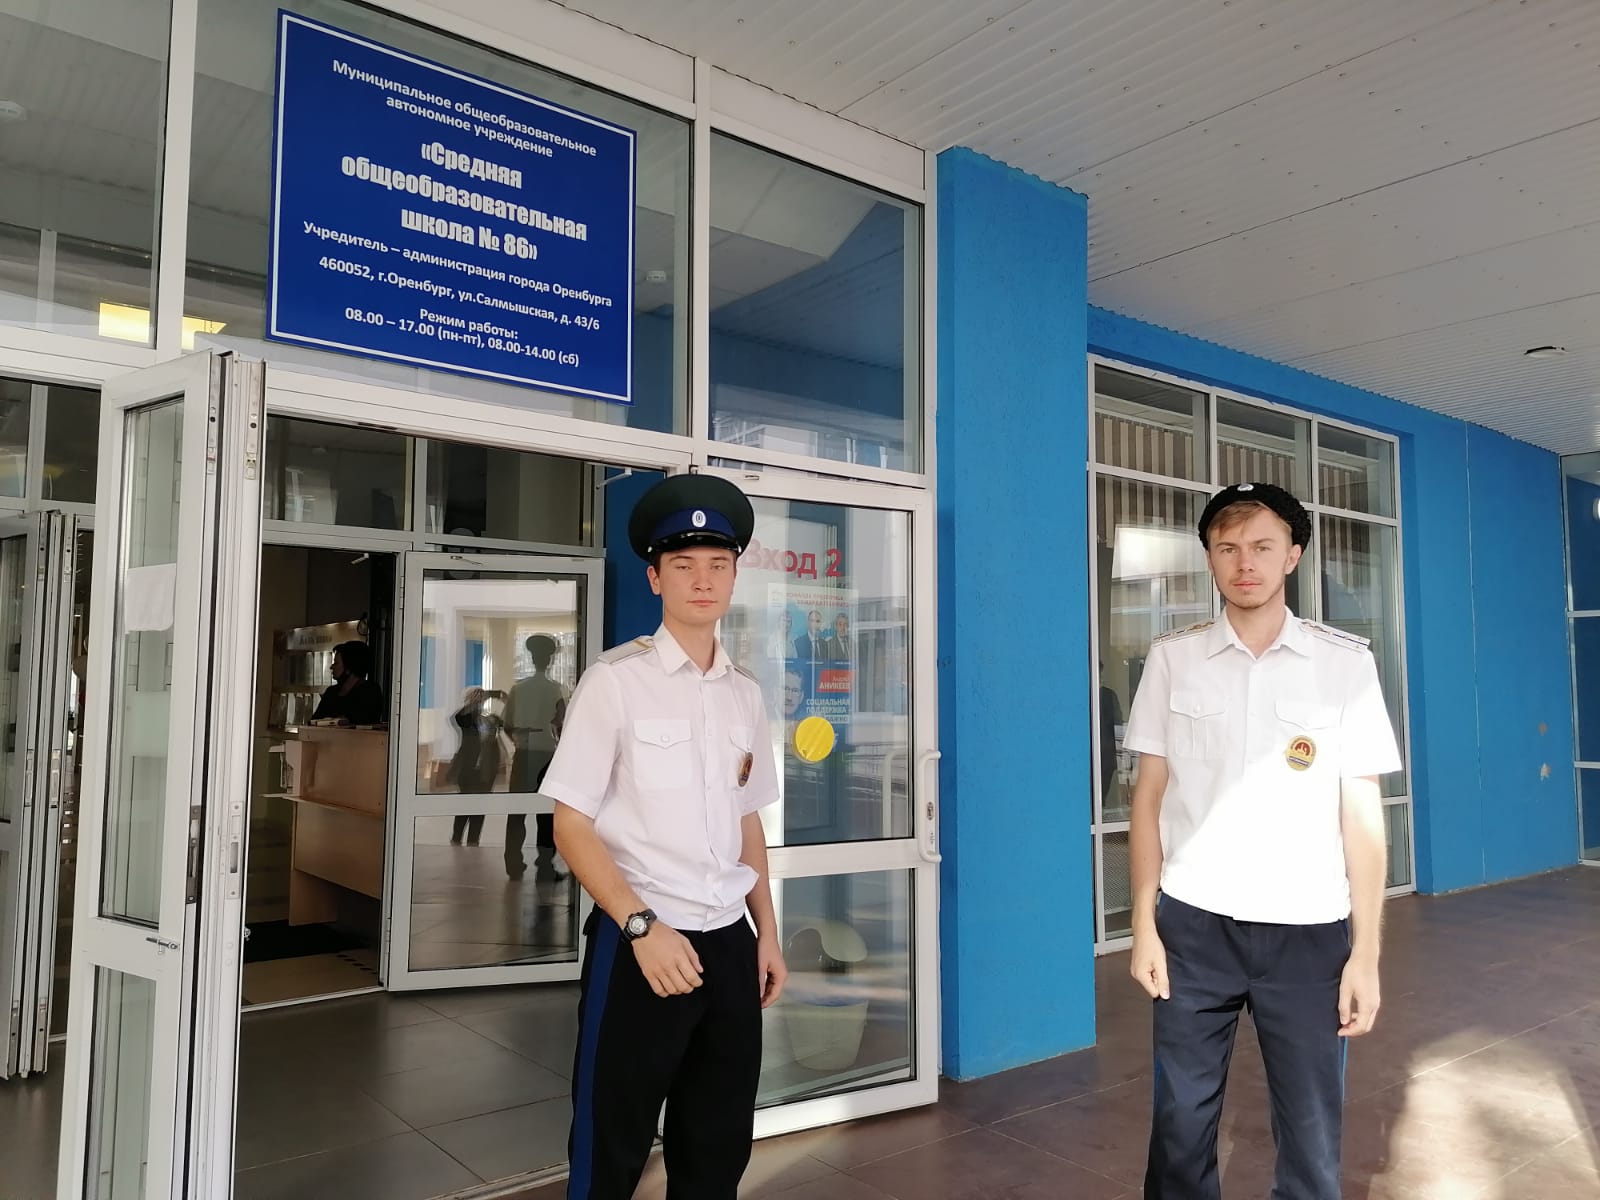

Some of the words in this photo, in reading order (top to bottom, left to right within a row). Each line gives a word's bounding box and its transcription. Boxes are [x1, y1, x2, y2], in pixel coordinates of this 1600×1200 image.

[333, 60, 451, 109] Муниципальное
[454, 102, 597, 157] общеобразовательное
[386, 97, 471, 131] автономное
[474, 124, 553, 158] учреждение
[421, 142, 522, 189] «Средняя
[341, 156, 587, 241] общеобразовательная
[303, 221, 388, 254] Учредитель
[403, 248, 505, 283] администрация
[508, 275, 550, 293] города
[552, 283, 613, 307] Оренбурга
[401, 209, 474, 245] школа
[478, 226, 500, 252] №
[503, 231, 538, 260] 86»
[319, 256, 375, 282] 460052,
[378, 272, 455, 301] г.Оренбург,
[458, 289, 558, 323] ул.Салмышская,
[560, 315, 572, 325] д.
[574, 315, 600, 331] 43/6
[345, 308, 384, 326] 08.00
[399, 320, 435, 338] 17.00
[438, 328, 485, 350] (пн-пт),
[487, 338, 556, 362] 08.00-14.00
[558, 351, 580, 369] (сб)
[420, 308, 466, 333] Режим
[469, 321, 519, 341] работы:
[742, 540, 817, 580] Вход
[826, 548, 842, 577] 2
